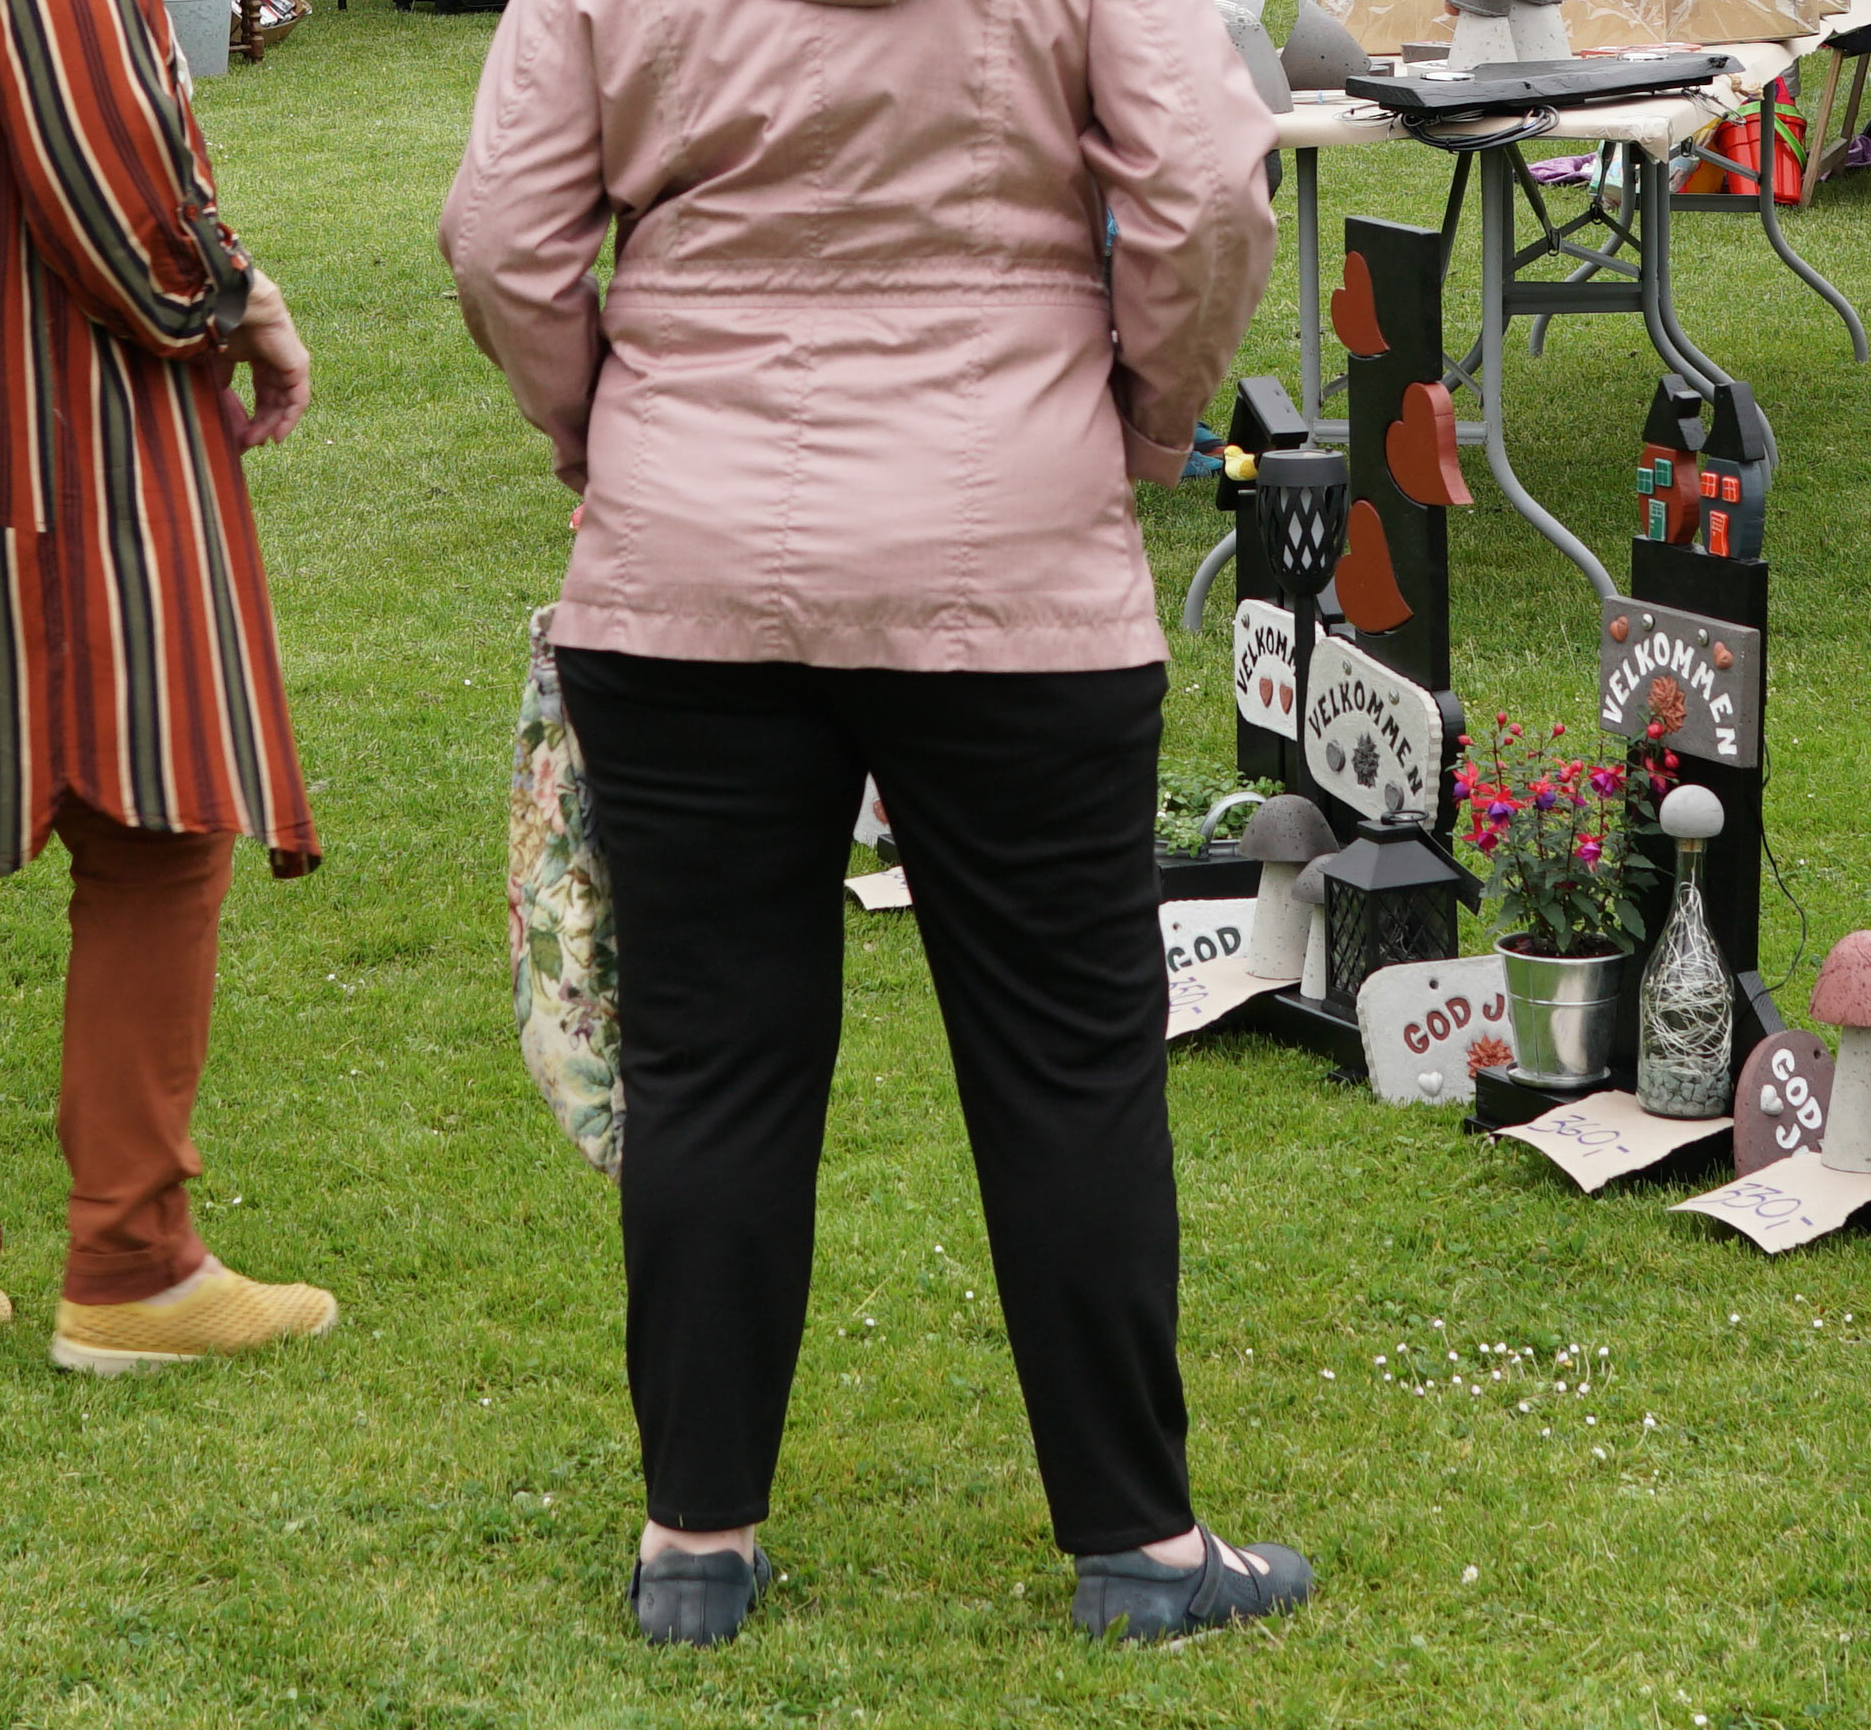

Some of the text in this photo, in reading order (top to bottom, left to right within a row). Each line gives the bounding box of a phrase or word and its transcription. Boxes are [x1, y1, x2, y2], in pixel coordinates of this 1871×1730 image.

[1237, 626, 1297, 695] VELKOMM
[1602, 632, 1738, 755] VELKOMMEN
[1308, 680, 1424, 797] VELKOMMEN
[1403, 997, 1472, 1054] GOD
[1772, 1048, 1823, 1130] GOD
